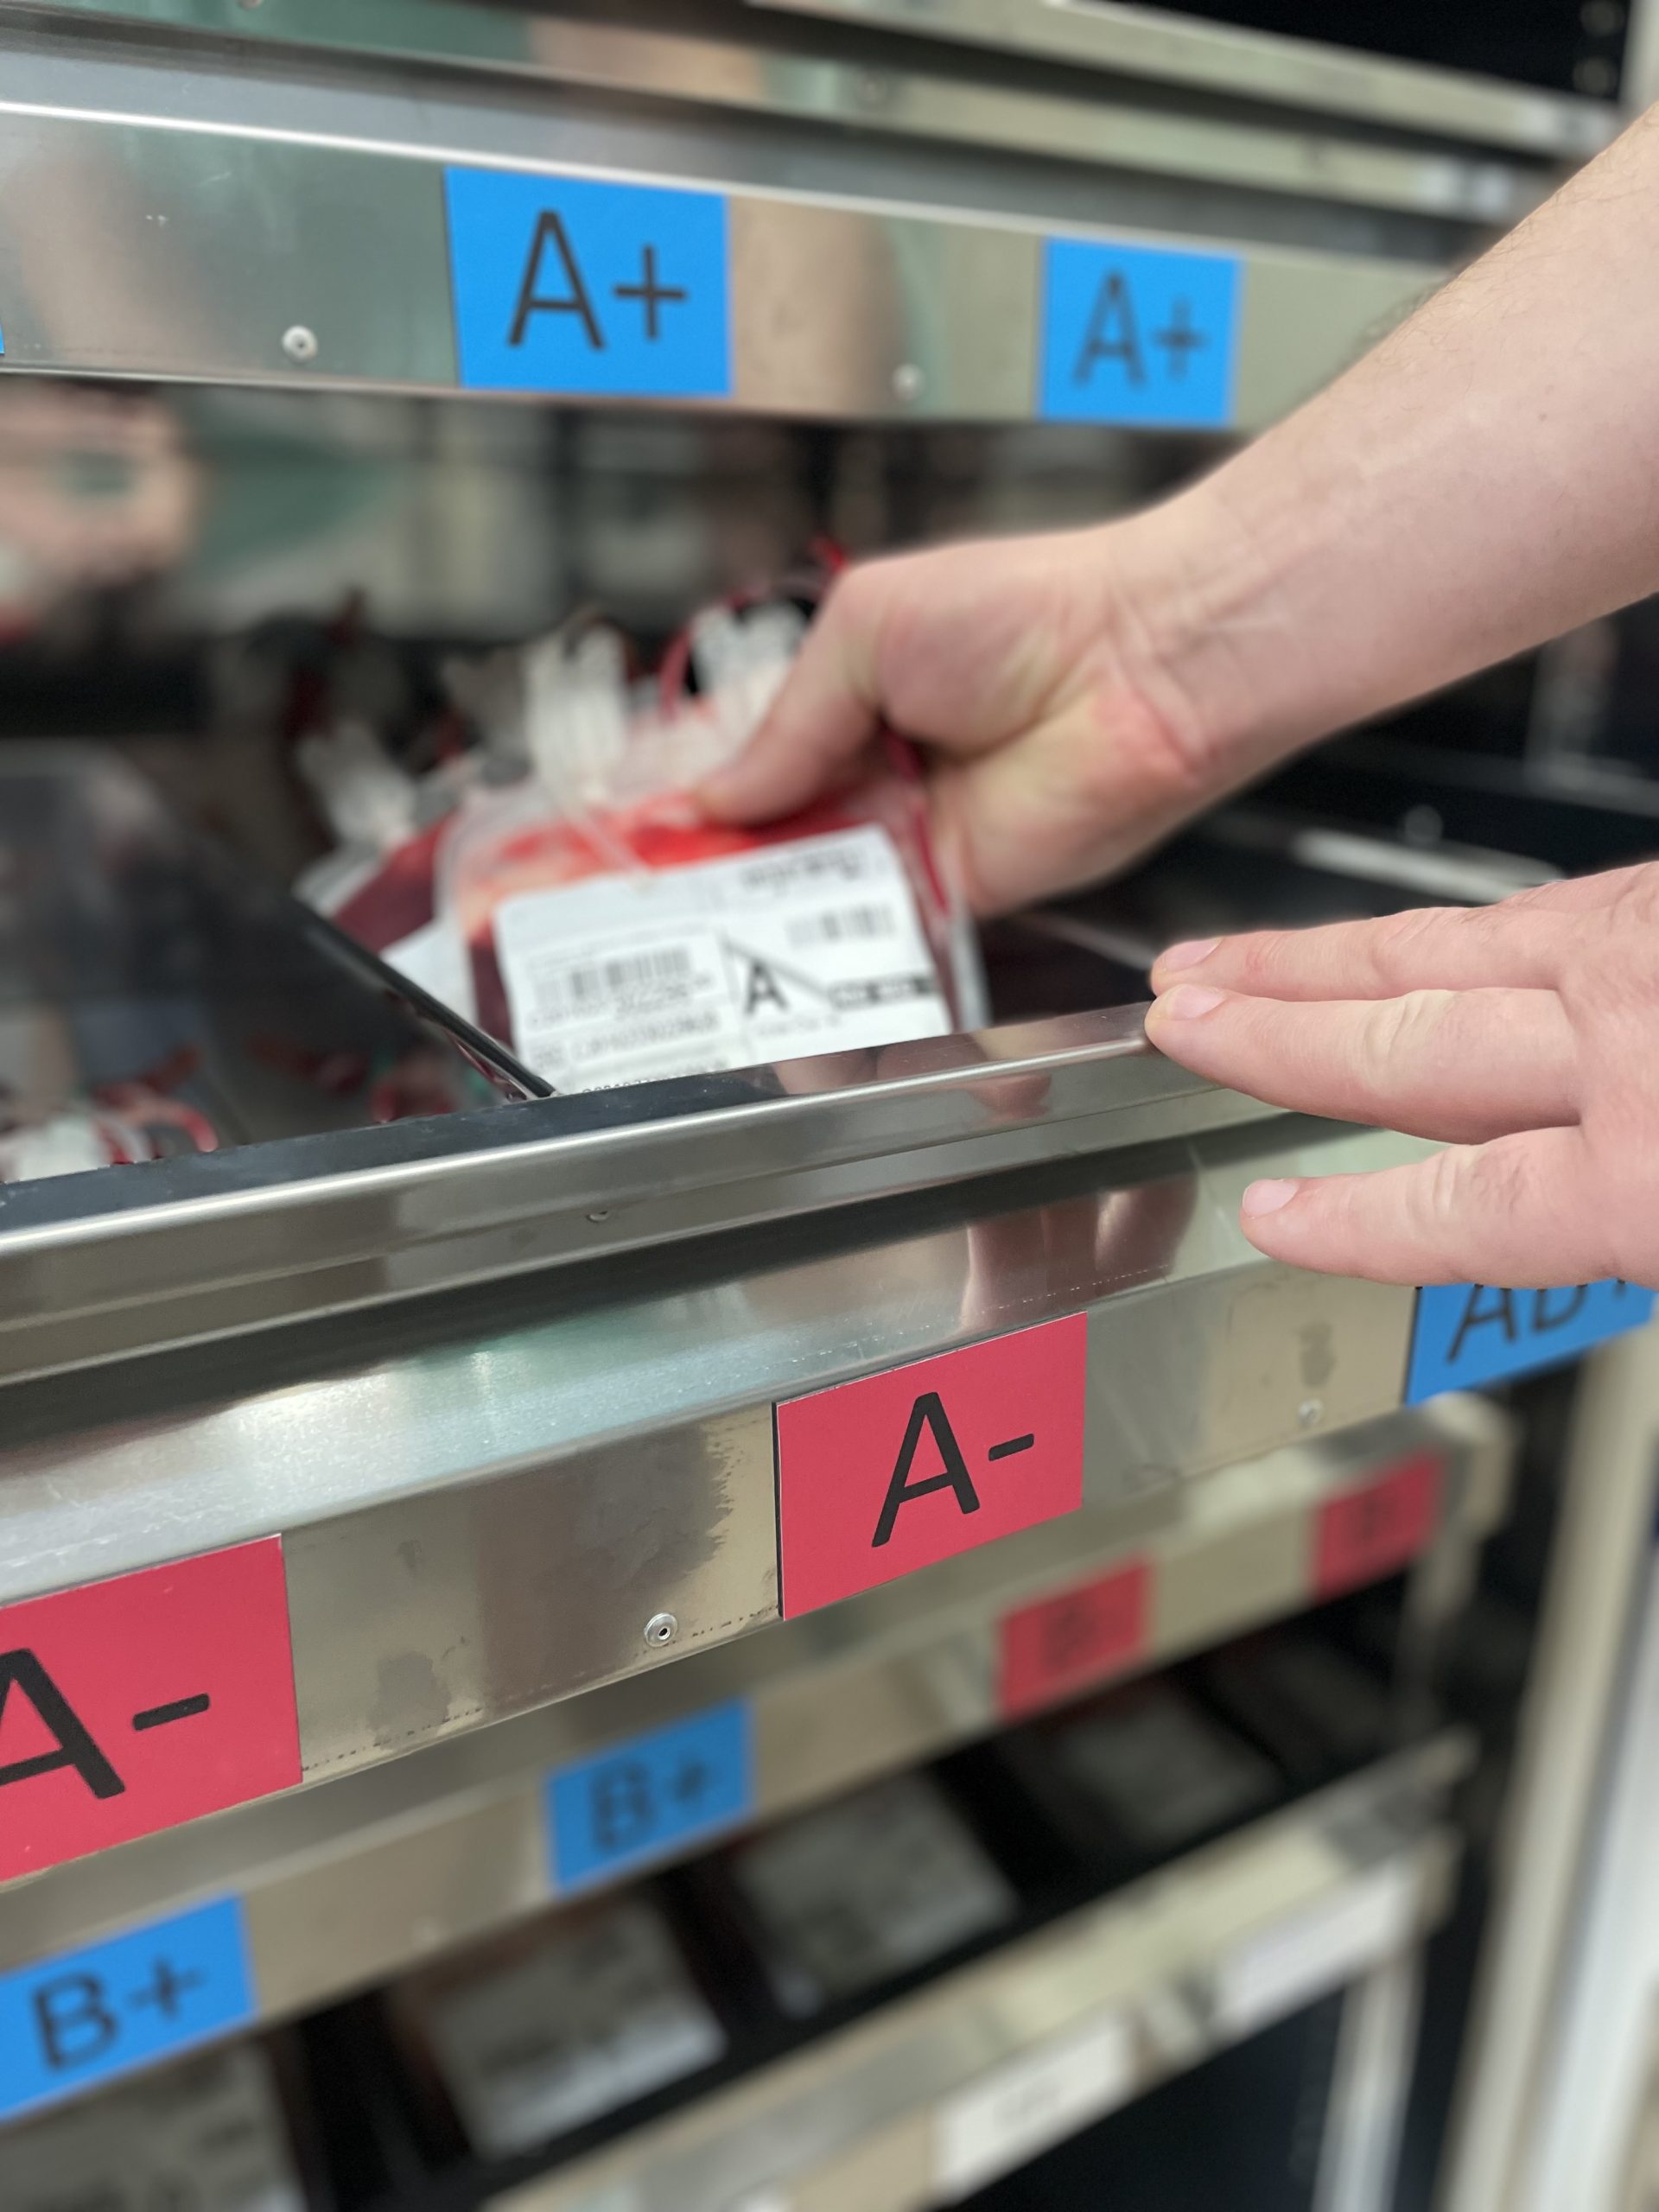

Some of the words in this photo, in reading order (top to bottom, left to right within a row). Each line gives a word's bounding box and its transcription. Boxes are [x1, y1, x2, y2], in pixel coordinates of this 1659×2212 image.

[507, 208, 687, 350] A+
[1072, 269, 1207, 387] A+
[745, 957, 790, 1015] A
[871, 1391, 1036, 1548] A-
[0, 1647, 211, 1800] A-
[31, 1955, 207, 2071] B+
